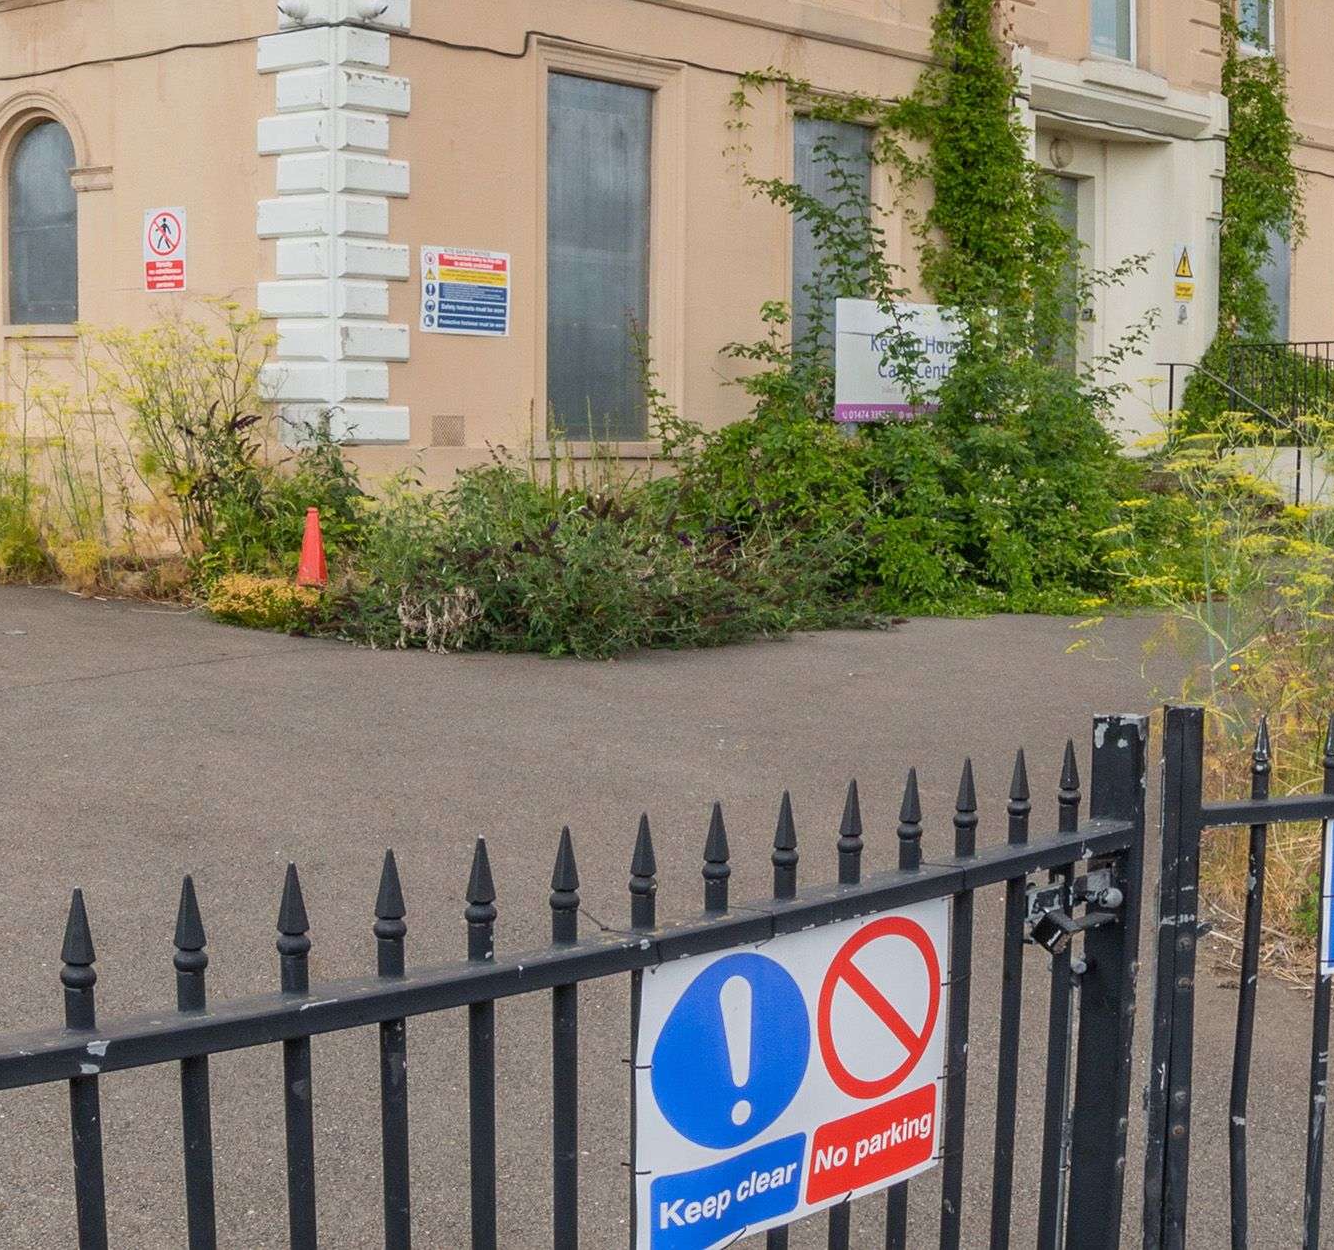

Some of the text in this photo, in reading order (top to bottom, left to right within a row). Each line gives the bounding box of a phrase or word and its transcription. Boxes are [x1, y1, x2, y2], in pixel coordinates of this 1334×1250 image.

[814, 1112, 932, 1174] No parking
[660, 1162, 797, 1229] Keep clear
